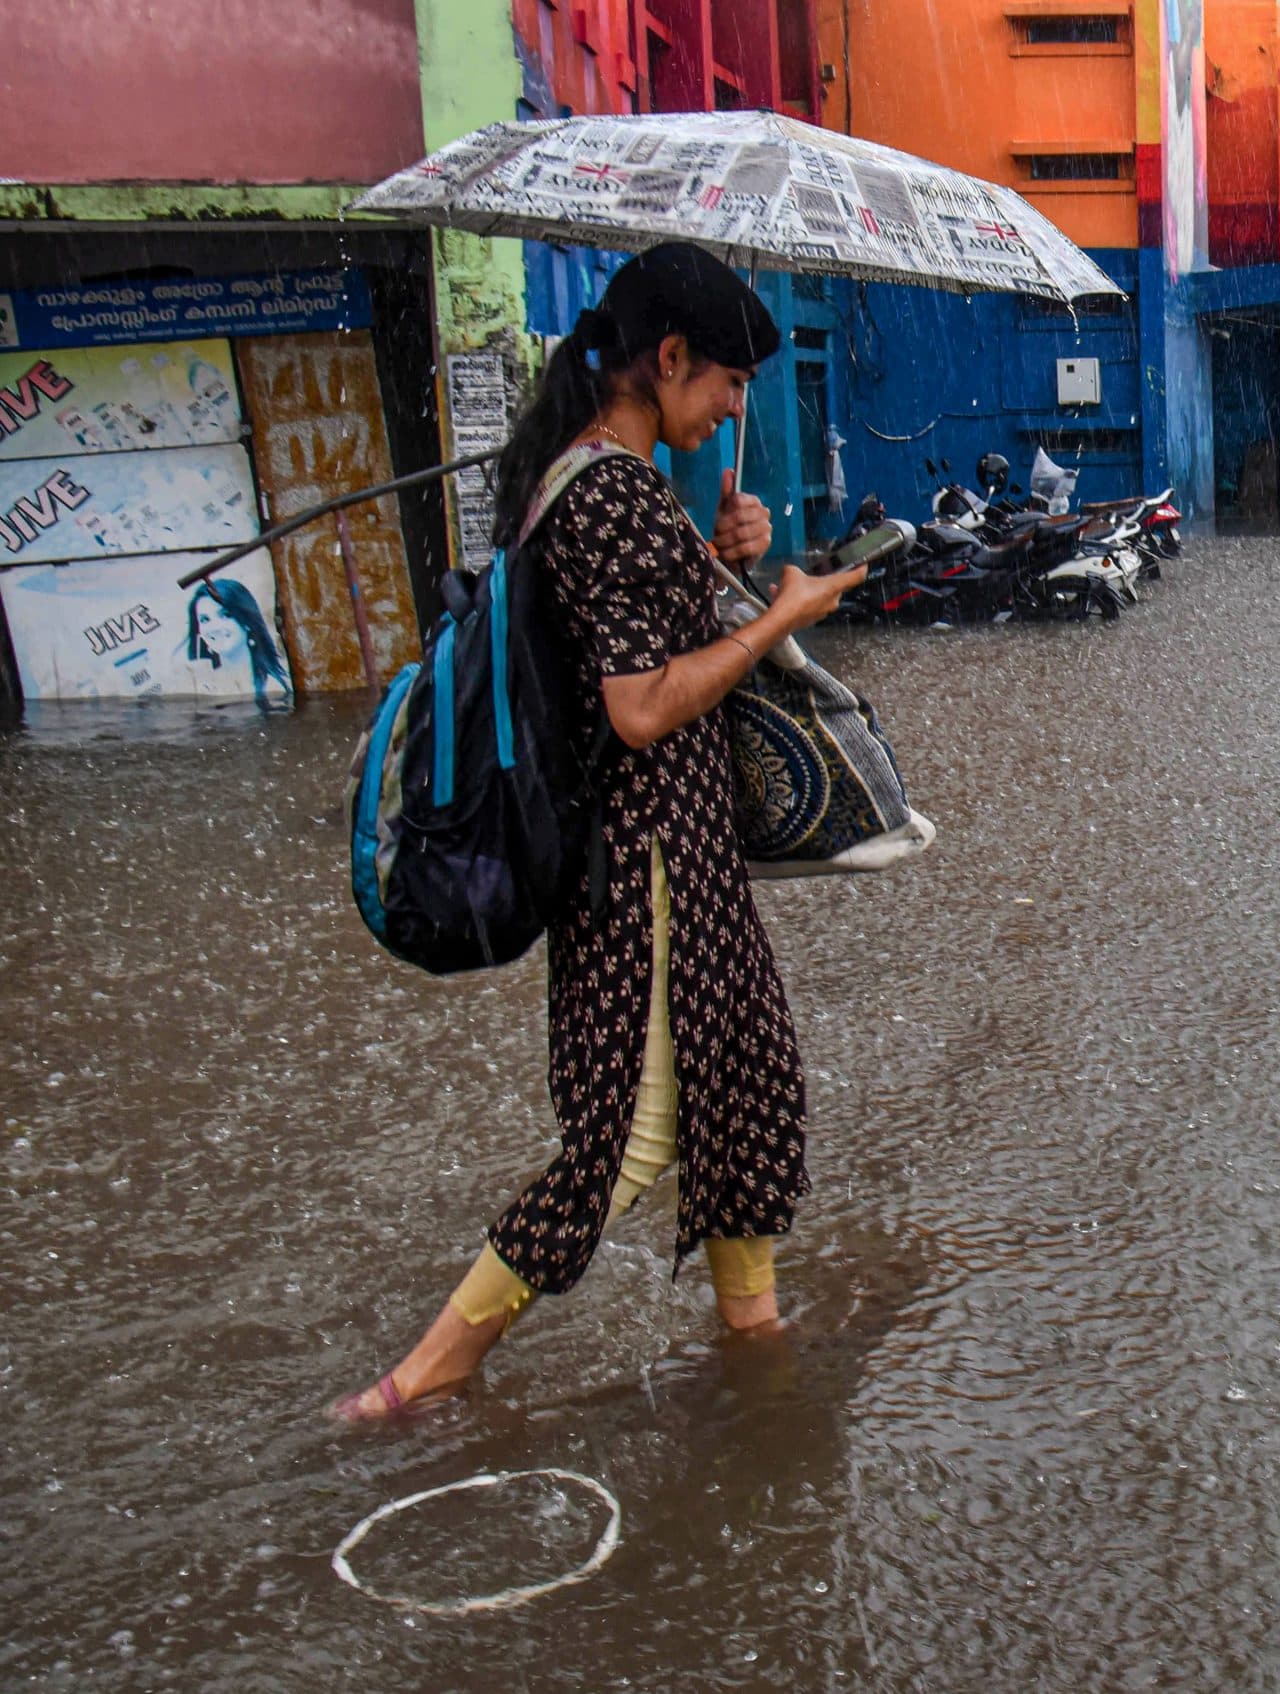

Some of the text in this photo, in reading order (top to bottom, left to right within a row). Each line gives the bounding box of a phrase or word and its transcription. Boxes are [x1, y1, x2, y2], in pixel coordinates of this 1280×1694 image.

[969, 237, 1034, 258] TODAY
[985, 261, 1042, 282] GOOD
[0, 357, 75, 444] IVE
[0, 468, 93, 555] JIVE
[84, 604, 161, 656] JIVE
